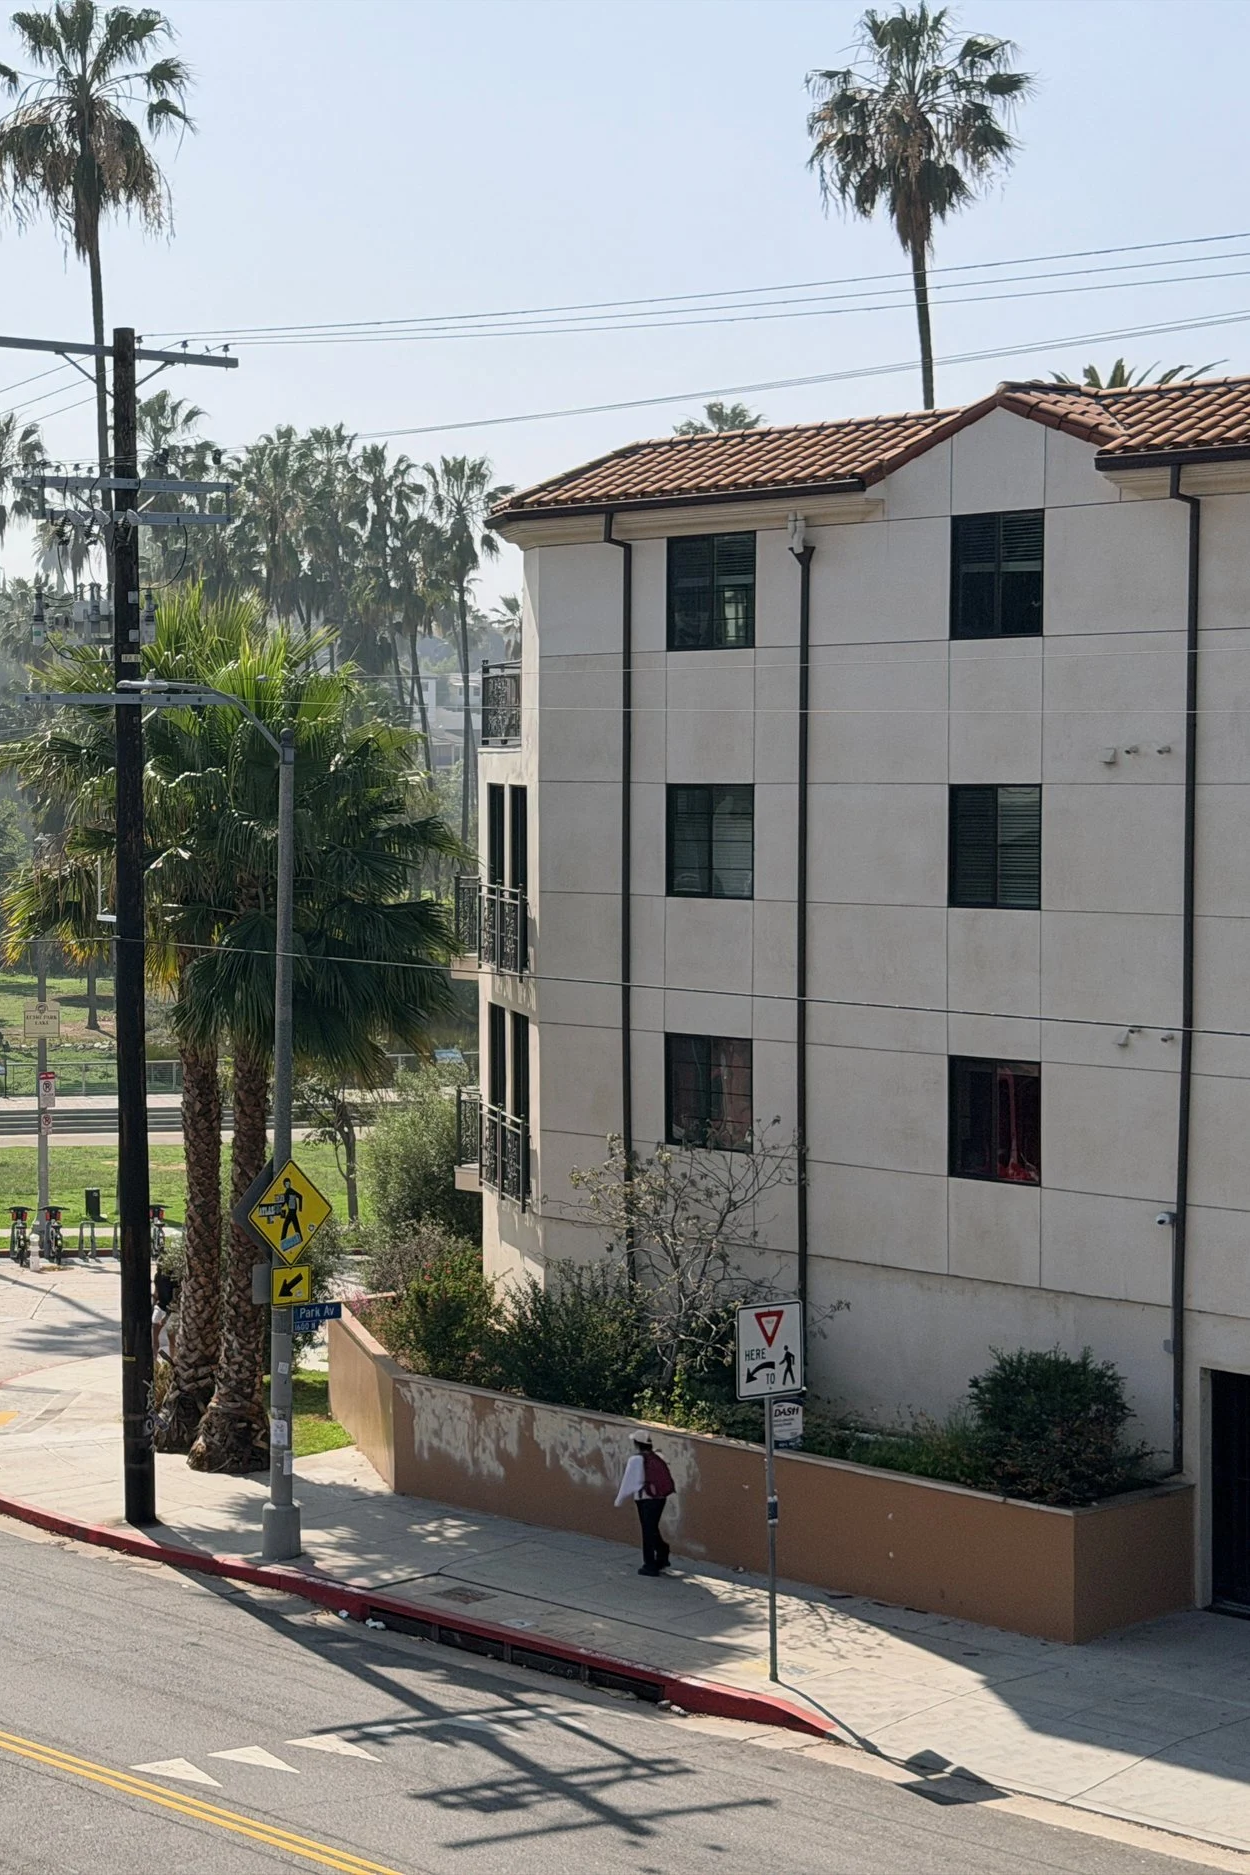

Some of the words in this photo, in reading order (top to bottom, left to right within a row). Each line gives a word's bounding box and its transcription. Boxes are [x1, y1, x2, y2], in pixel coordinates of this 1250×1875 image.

[299, 1307, 320, 1318] Park
[323, 1305, 334, 1317] Av
[744, 1348, 767, 1362] HERE
[766, 1372, 776, 1385] TO
[774, 1406, 799, 1417] DASH
